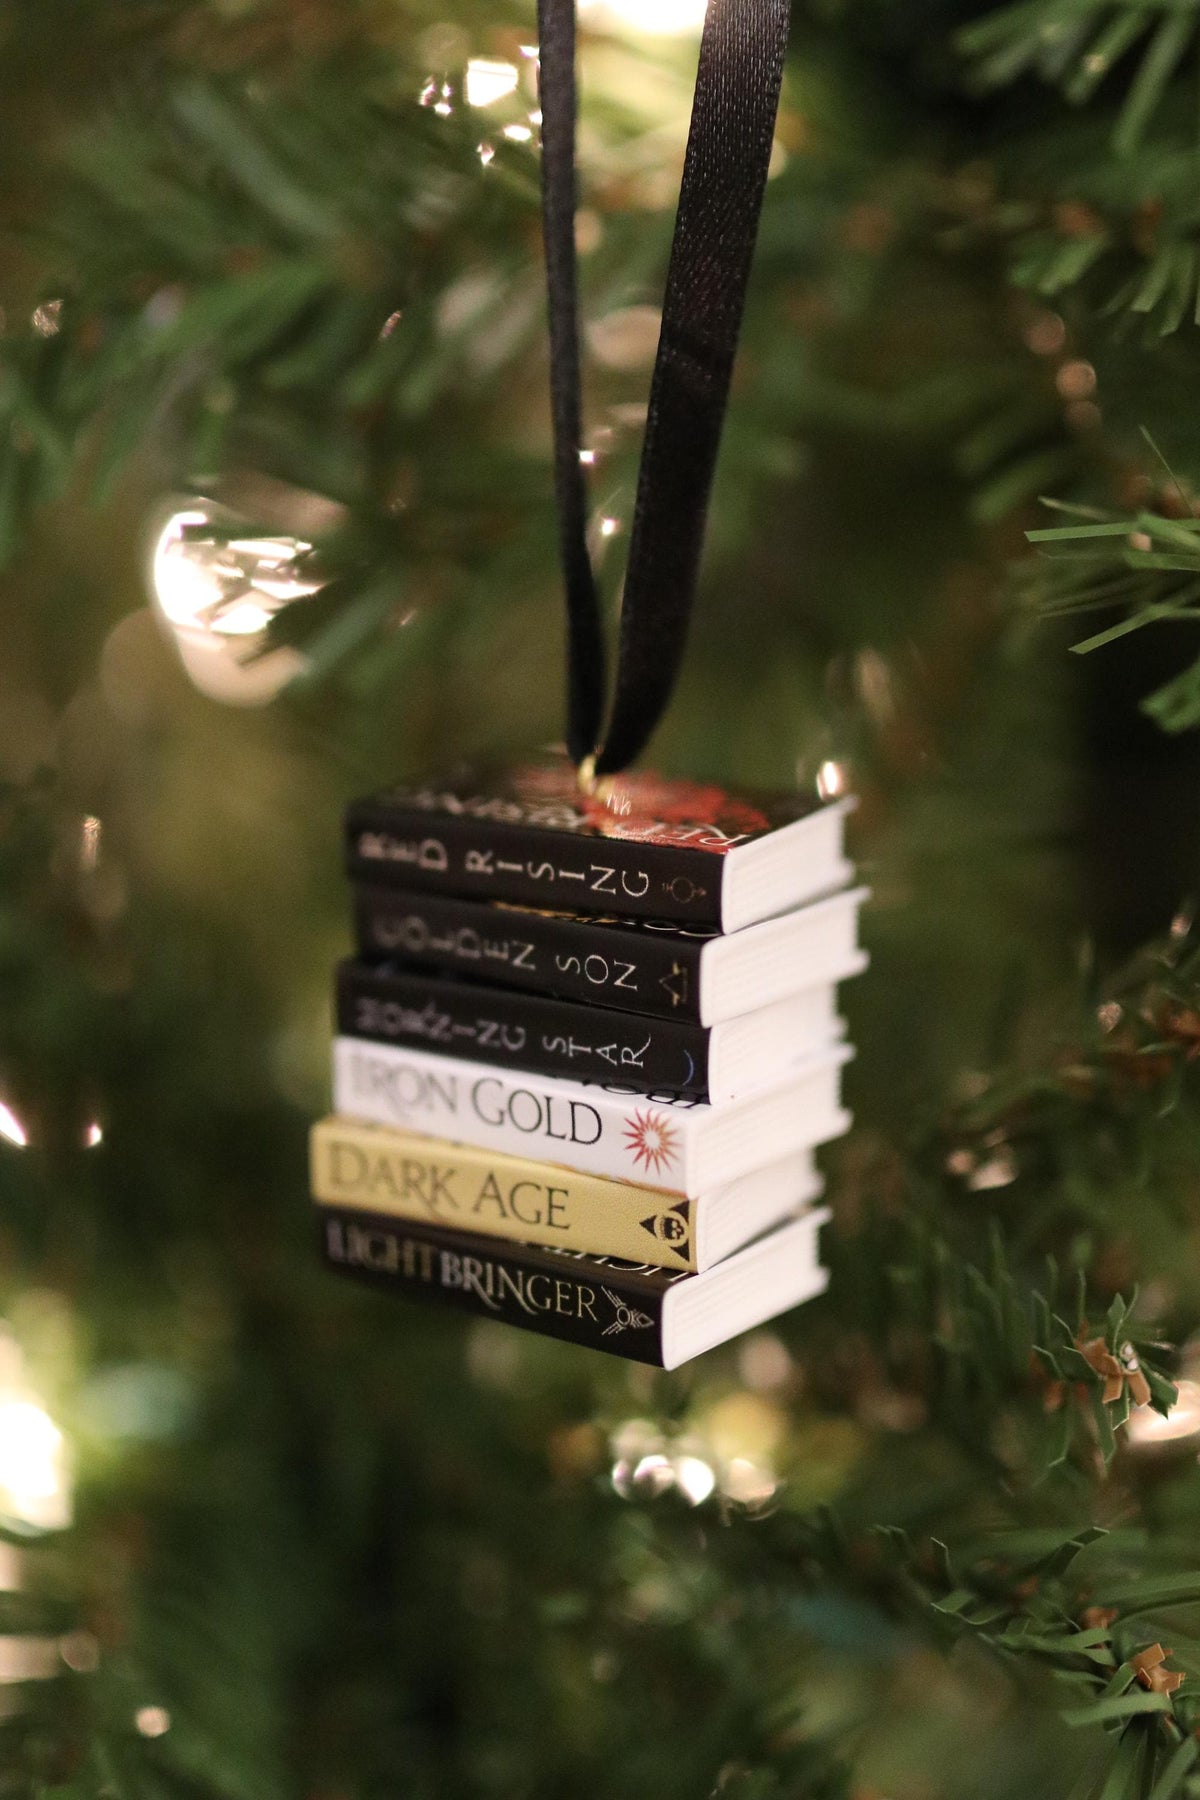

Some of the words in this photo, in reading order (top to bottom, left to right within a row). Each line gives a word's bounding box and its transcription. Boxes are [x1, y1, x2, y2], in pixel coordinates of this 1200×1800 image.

[358, 831, 448, 871] RED
[465, 849, 650, 897] RISING
[373, 914, 537, 971] GOLDEN
[555, 954, 638, 991] SON
[542, 1034, 652, 1069] STAR
[352, 1051, 458, 1116] IRON
[471, 1077, 603, 1145] GOLD
[327, 1142, 460, 1216] DARK
[472, 1170, 570, 1230] AGE
[439, 1251, 599, 1322] BRINGER
